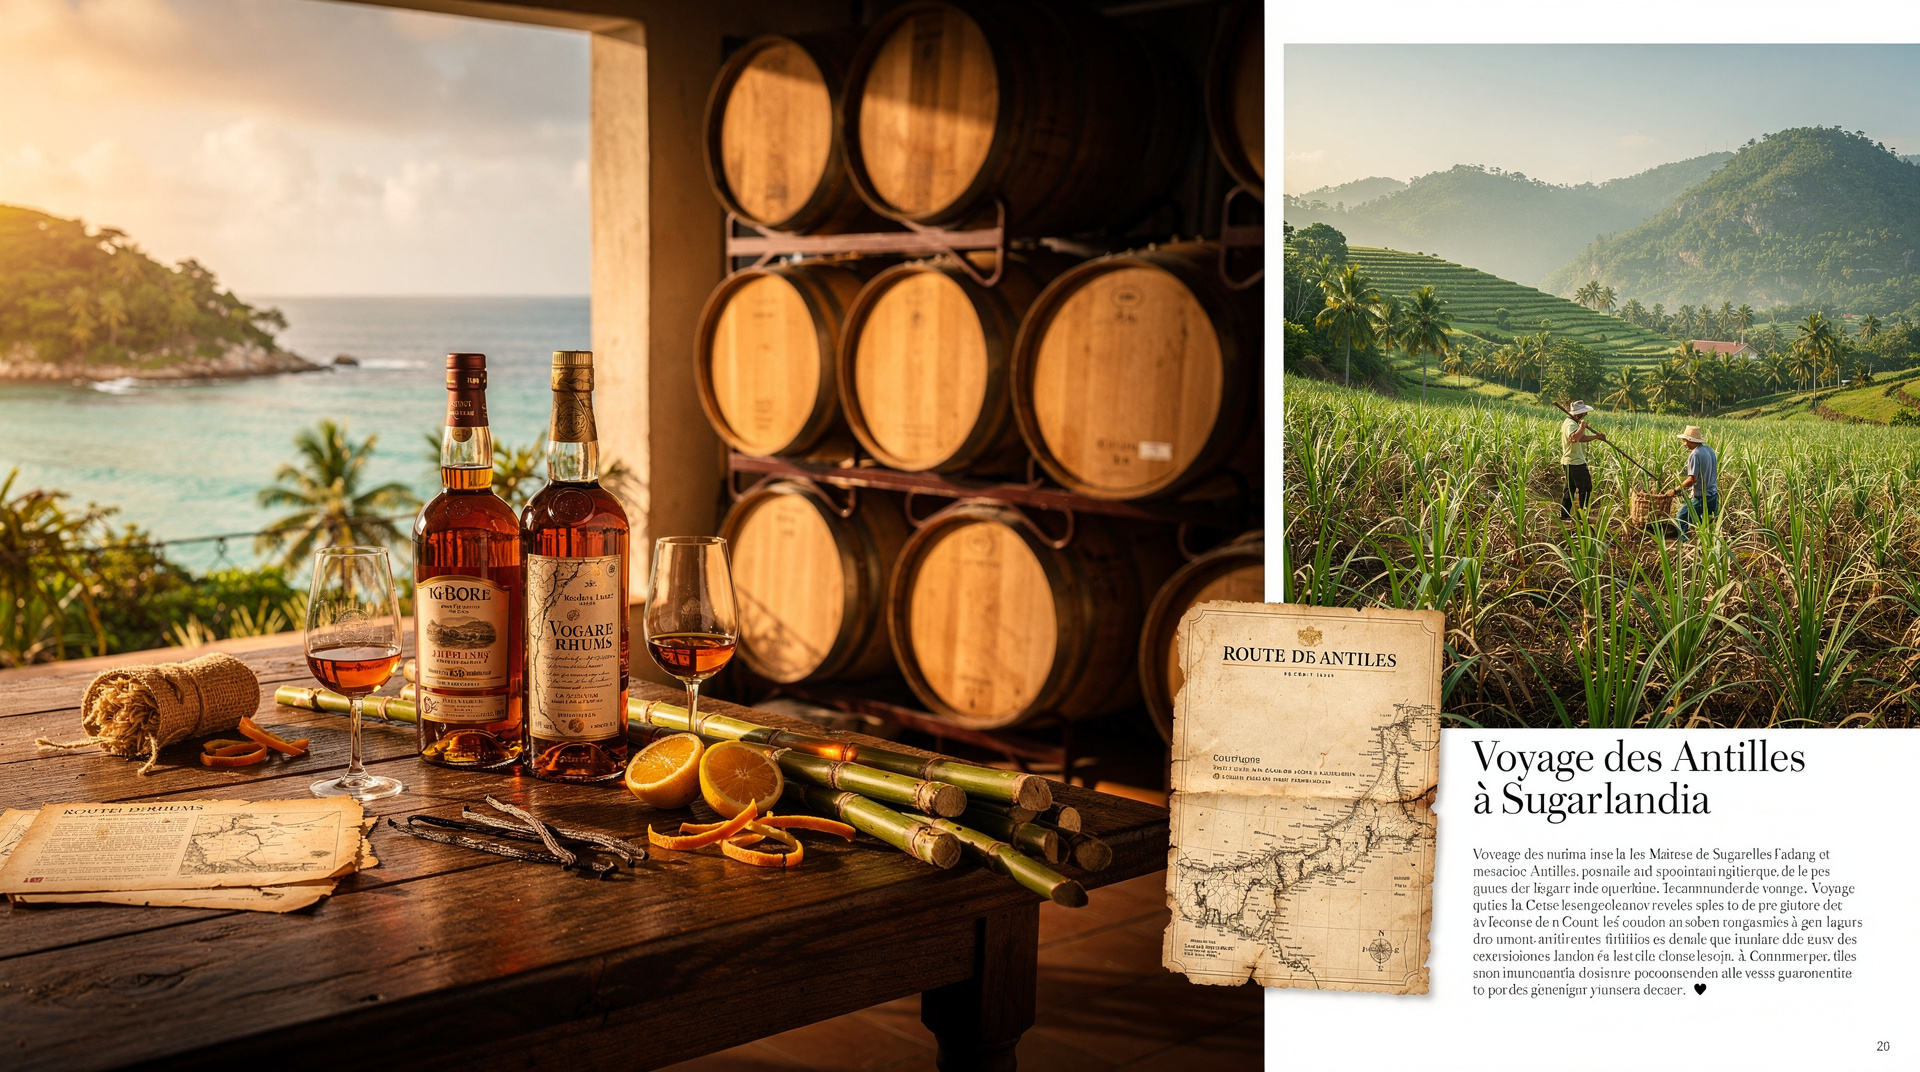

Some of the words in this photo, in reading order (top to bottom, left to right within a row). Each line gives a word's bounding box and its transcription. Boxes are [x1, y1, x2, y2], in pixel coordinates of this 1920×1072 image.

[549, 620, 613, 637] VOGARE
[555, 636, 612, 650] RHUMS
[1223, 645, 1285, 662] ROUTE
[1320, 651, 1397, 667] ANTILES
[1471, 739, 1594, 782] Voyage
[1603, 738, 1662, 772] des
[1670, 738, 1805, 772] Antilles
[1472, 780, 1493, 814] à
[1501, 780, 1711, 824] Sugarlandia
[1524, 847, 1544, 860] des
[1615, 847, 1626, 860] la
[1629, 847, 1646, 861] les
[1695, 847, 1710, 861] de
[1781, 864, 1795, 878] de
[1798, 864, 1808, 878] le
[1727, 900, 1739, 911] to
[1741, 898, 1756, 912] de
[1758, 902, 1778, 914] pre
[1535, 915, 1550, 928] de
[1561, 915, 1599, 928] Count
[1709, 936, 1732, 949] que
[1837, 932, 1858, 946] des
[1472, 985, 1485, 996] to
[1877, 1041, 1890, 1051] 20
